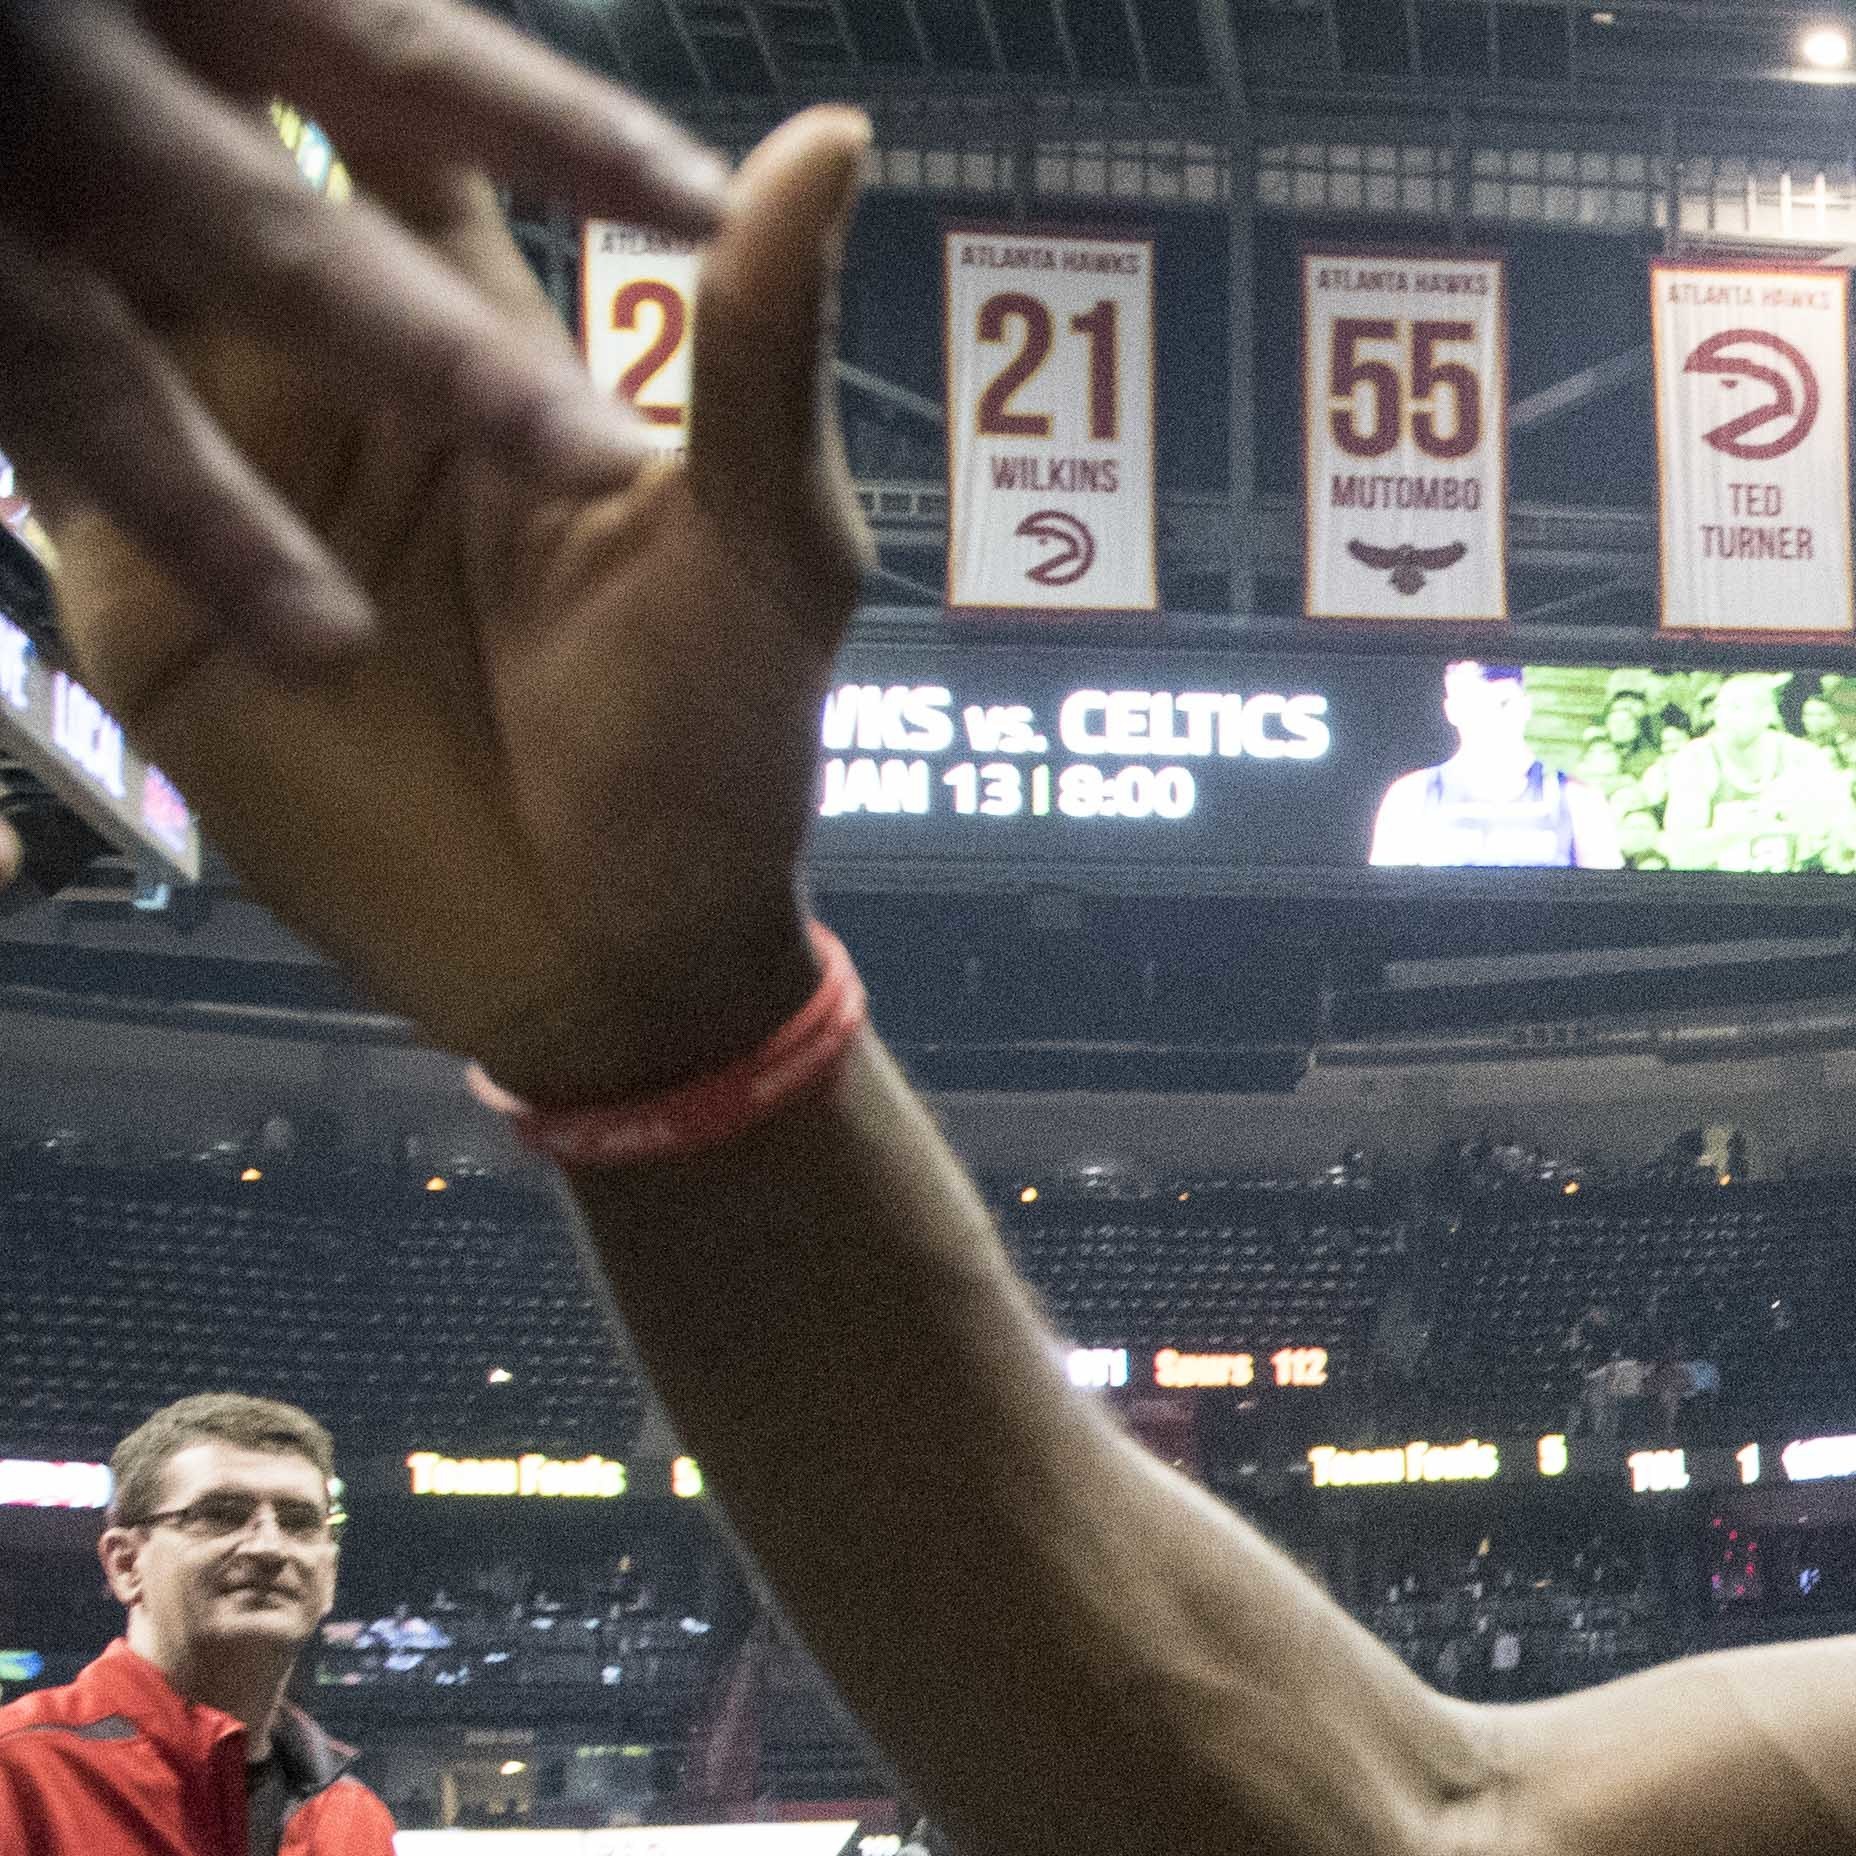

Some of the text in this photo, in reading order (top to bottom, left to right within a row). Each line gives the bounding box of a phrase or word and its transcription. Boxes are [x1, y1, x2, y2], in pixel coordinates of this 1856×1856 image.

[960, 246, 1142, 275] ATLANTA HAWKS
[1317, 268, 1490, 297] ATLANTA HAWKS
[975, 292, 1121, 440] 21
[1329, 318, 1483, 459] 55
[990, 453, 1120, 494] WILKINS
[1330, 474, 1483, 512] MUTOMBO
[1729, 482, 1783, 518] TED
[1701, 524, 1815, 562] TURNER
[963, 704, 1048, 754] vs.
[1058, 688, 1331, 760] CELTICS
[820, 756, 931, 817] JAN
